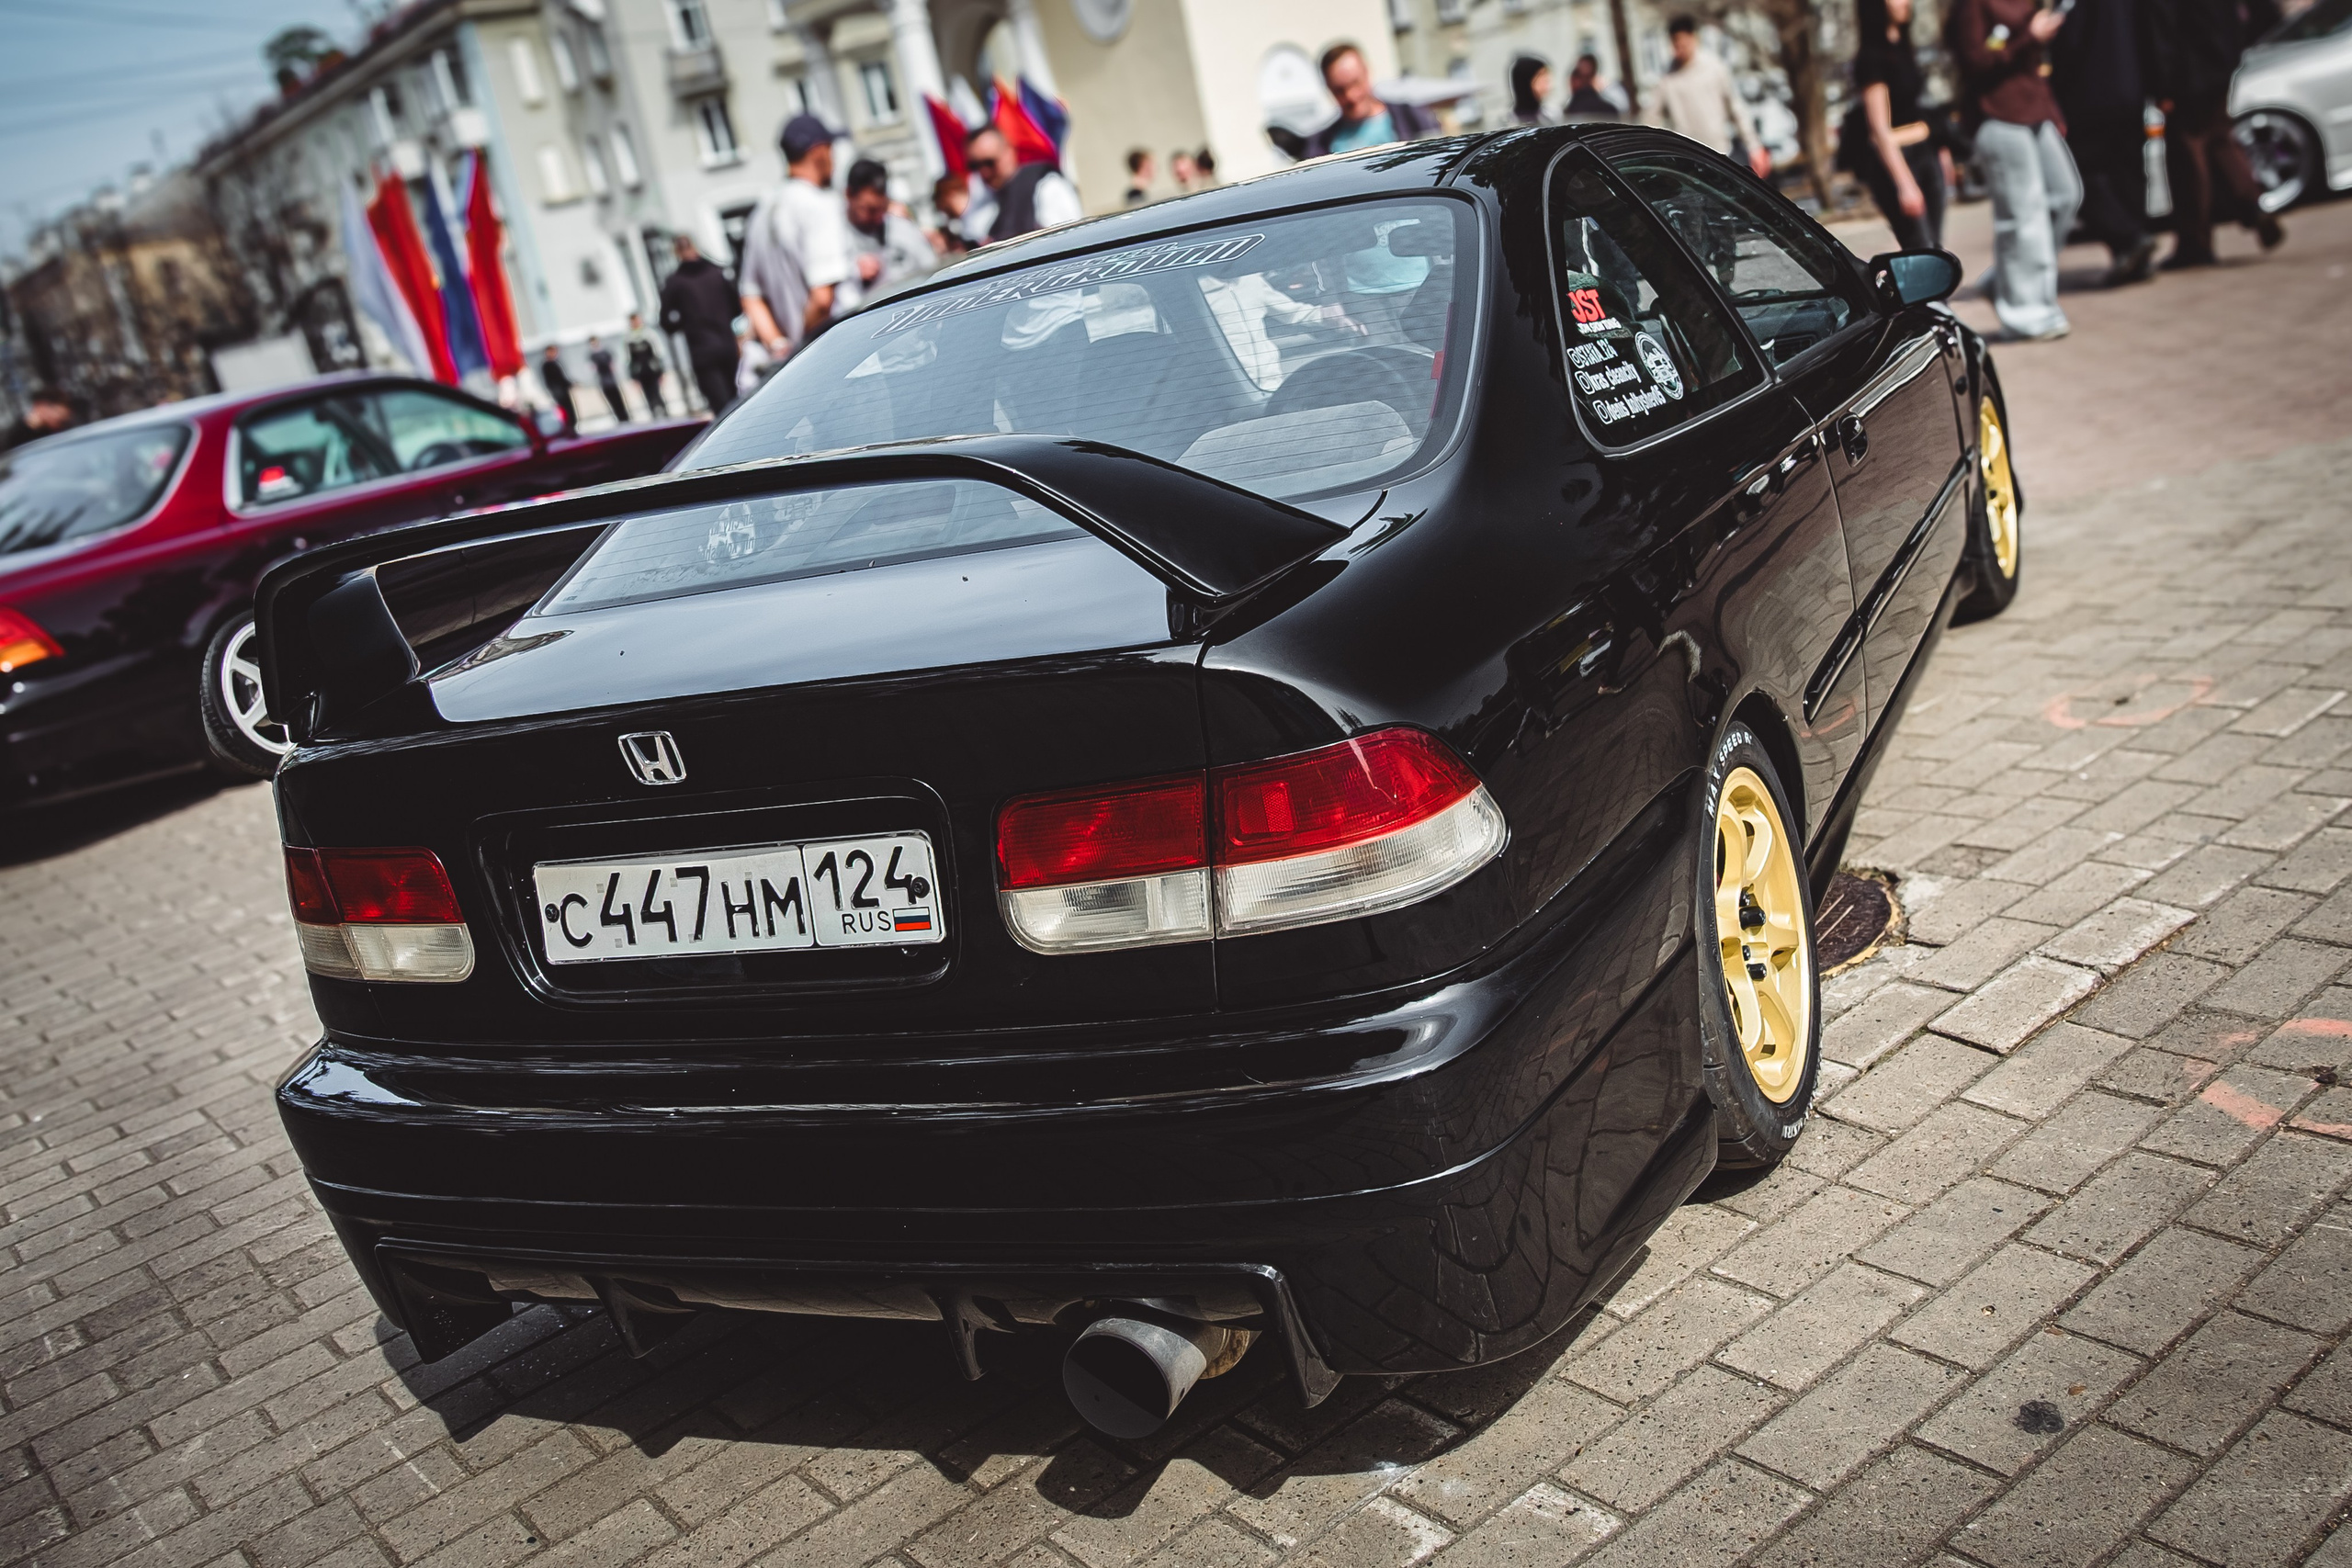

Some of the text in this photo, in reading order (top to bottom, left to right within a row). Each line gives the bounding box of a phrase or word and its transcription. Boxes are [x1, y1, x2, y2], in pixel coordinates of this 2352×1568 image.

[871, 233, 1265, 339] UNDERGROUND
[1567, 288, 1606, 323] JST
[1707, 766, 1721, 819] MAX
[1718, 731, 1743, 767] SPEED
[813, 845, 917, 911] 124
[842, 910, 892, 935] RUS
